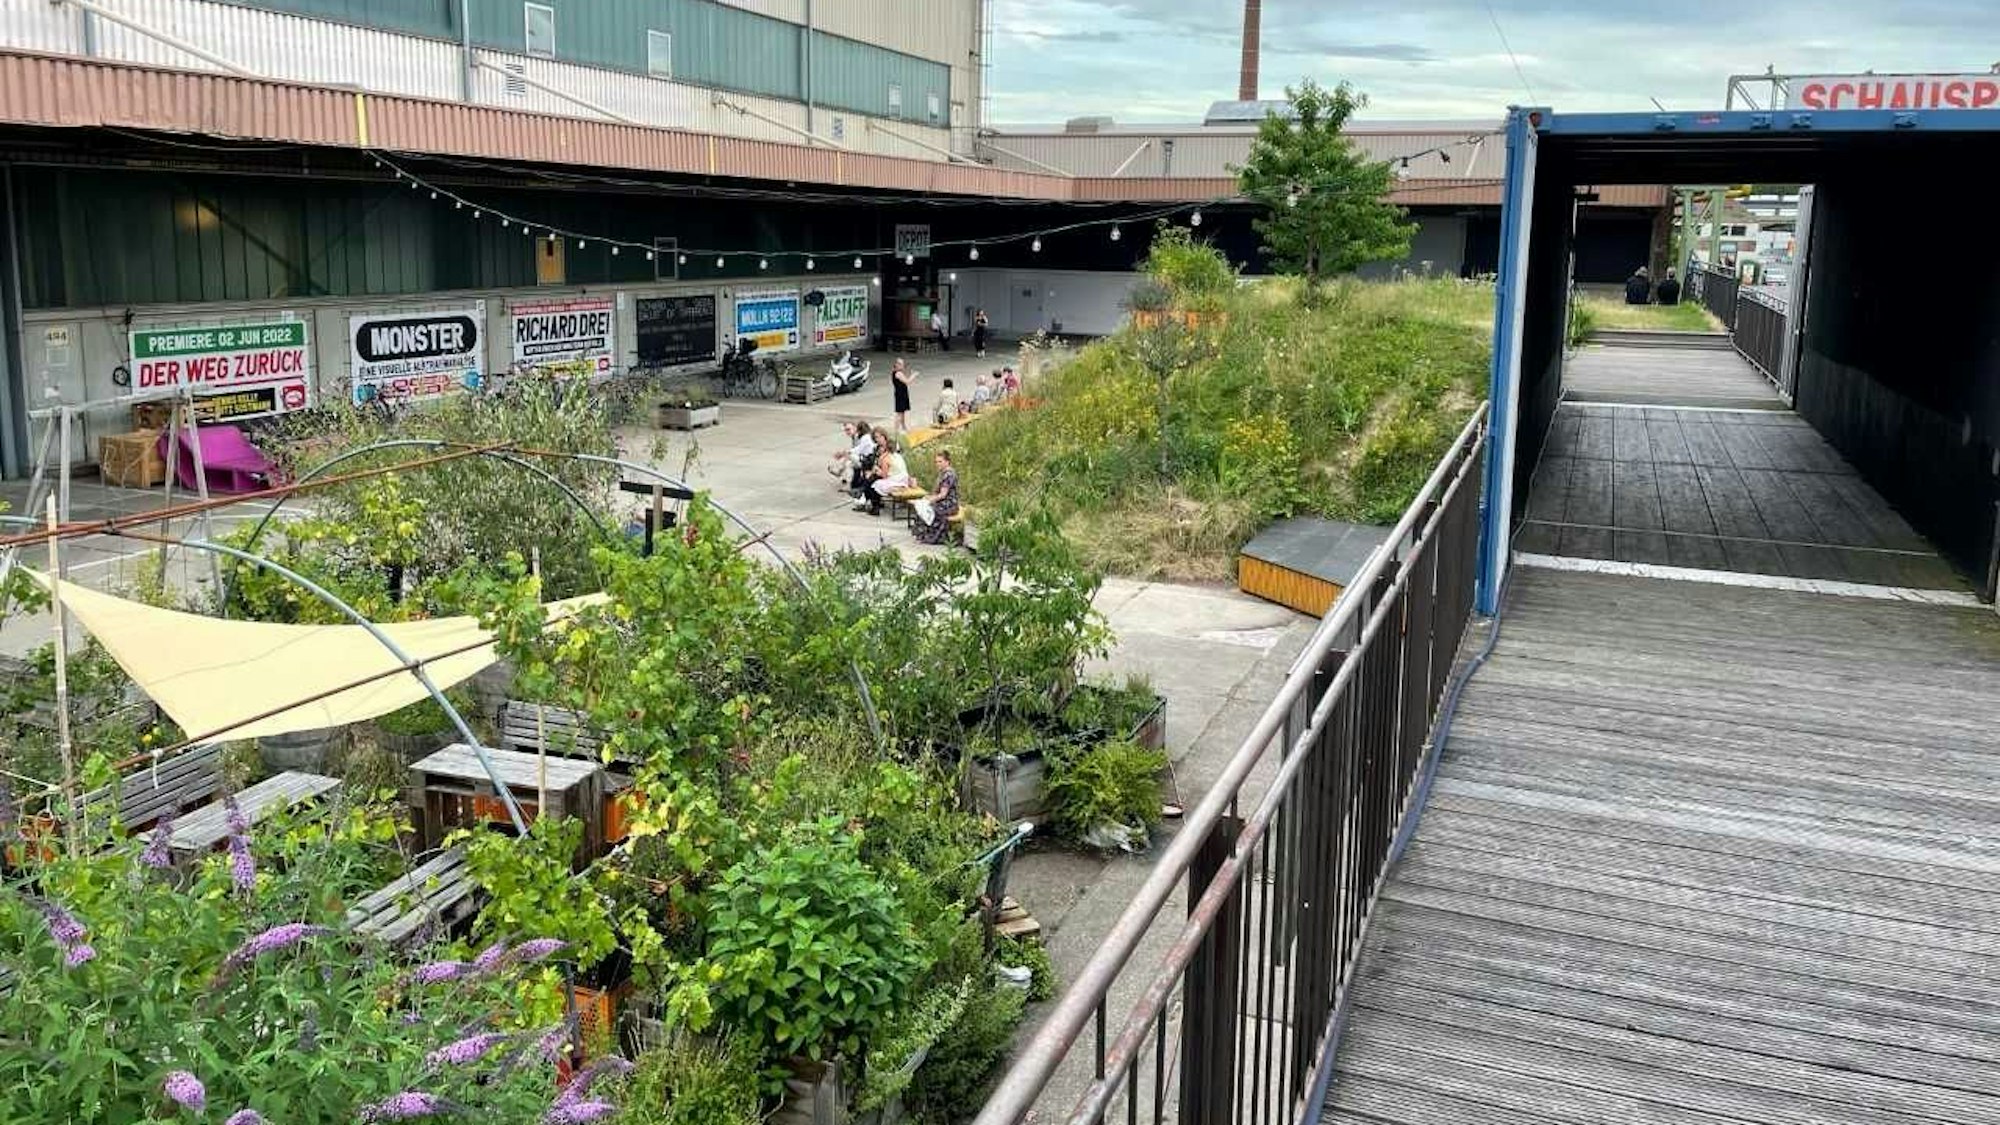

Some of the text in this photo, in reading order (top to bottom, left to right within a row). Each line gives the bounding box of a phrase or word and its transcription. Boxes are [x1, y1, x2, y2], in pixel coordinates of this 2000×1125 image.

[816, 297, 865, 323] FALSTAFF
[149, 328, 292, 352] PREMIERE: 02 JUN 2022
[371, 322, 464, 356] MONSTER
[516, 315, 577, 343] RICHARD
[579, 312, 610, 337] DREI
[140, 350, 304, 388] DER WEG ZURÜCK
